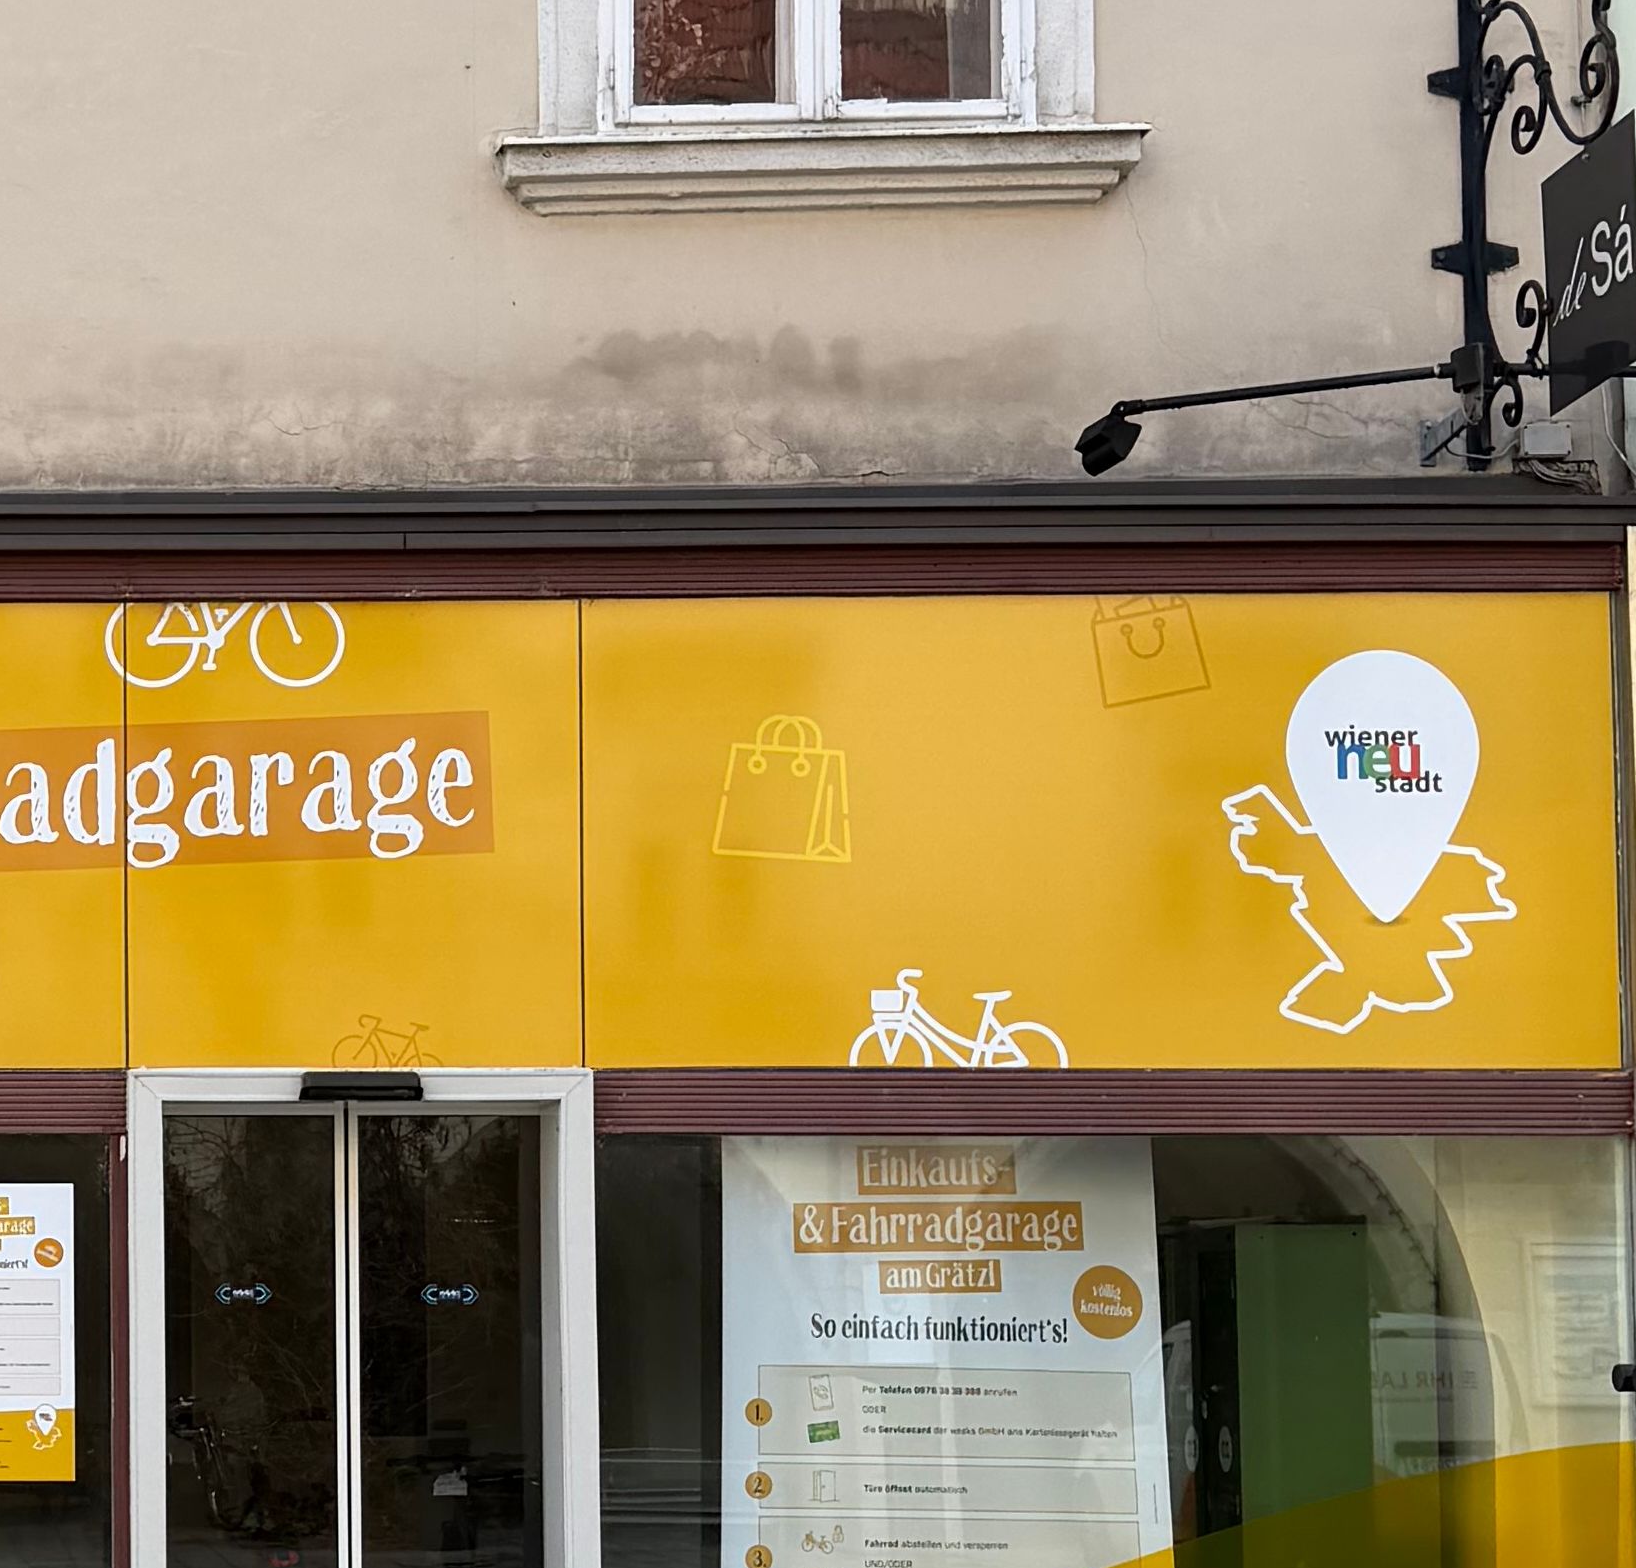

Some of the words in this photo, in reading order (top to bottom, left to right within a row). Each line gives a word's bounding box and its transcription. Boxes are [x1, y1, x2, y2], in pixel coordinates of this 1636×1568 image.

[1324, 724, 1419, 747] wiener
[1337, 743, 1421, 779] neu
[1374, 770, 1443, 793] stadt
[862, 1148, 1012, 1188] Einkaufs-
[798, 1205, 824, 1245] &
[831, 1205, 1079, 1252] Fahrradgarage
[885, 1267, 921, 1289] am
[925, 1261, 996, 1289] Grätzl
[1079, 1299, 1133, 1317] kostenlos
[810, 1313, 837, 1339] So
[841, 1313, 919, 1341] einfach
[879, 1386, 912, 1394] Telefon
[755, 1404, 764, 1422] 1.
[865, 1540, 899, 1549] Fahrrad
[901, 1540, 943, 1549] abstellen
[945, 1542, 961, 1550] und
[963, 1542, 1009, 1552] versperren
[752, 1550, 767, 1568] 3.
[865, 1560, 912, 1568] UND/ODER
